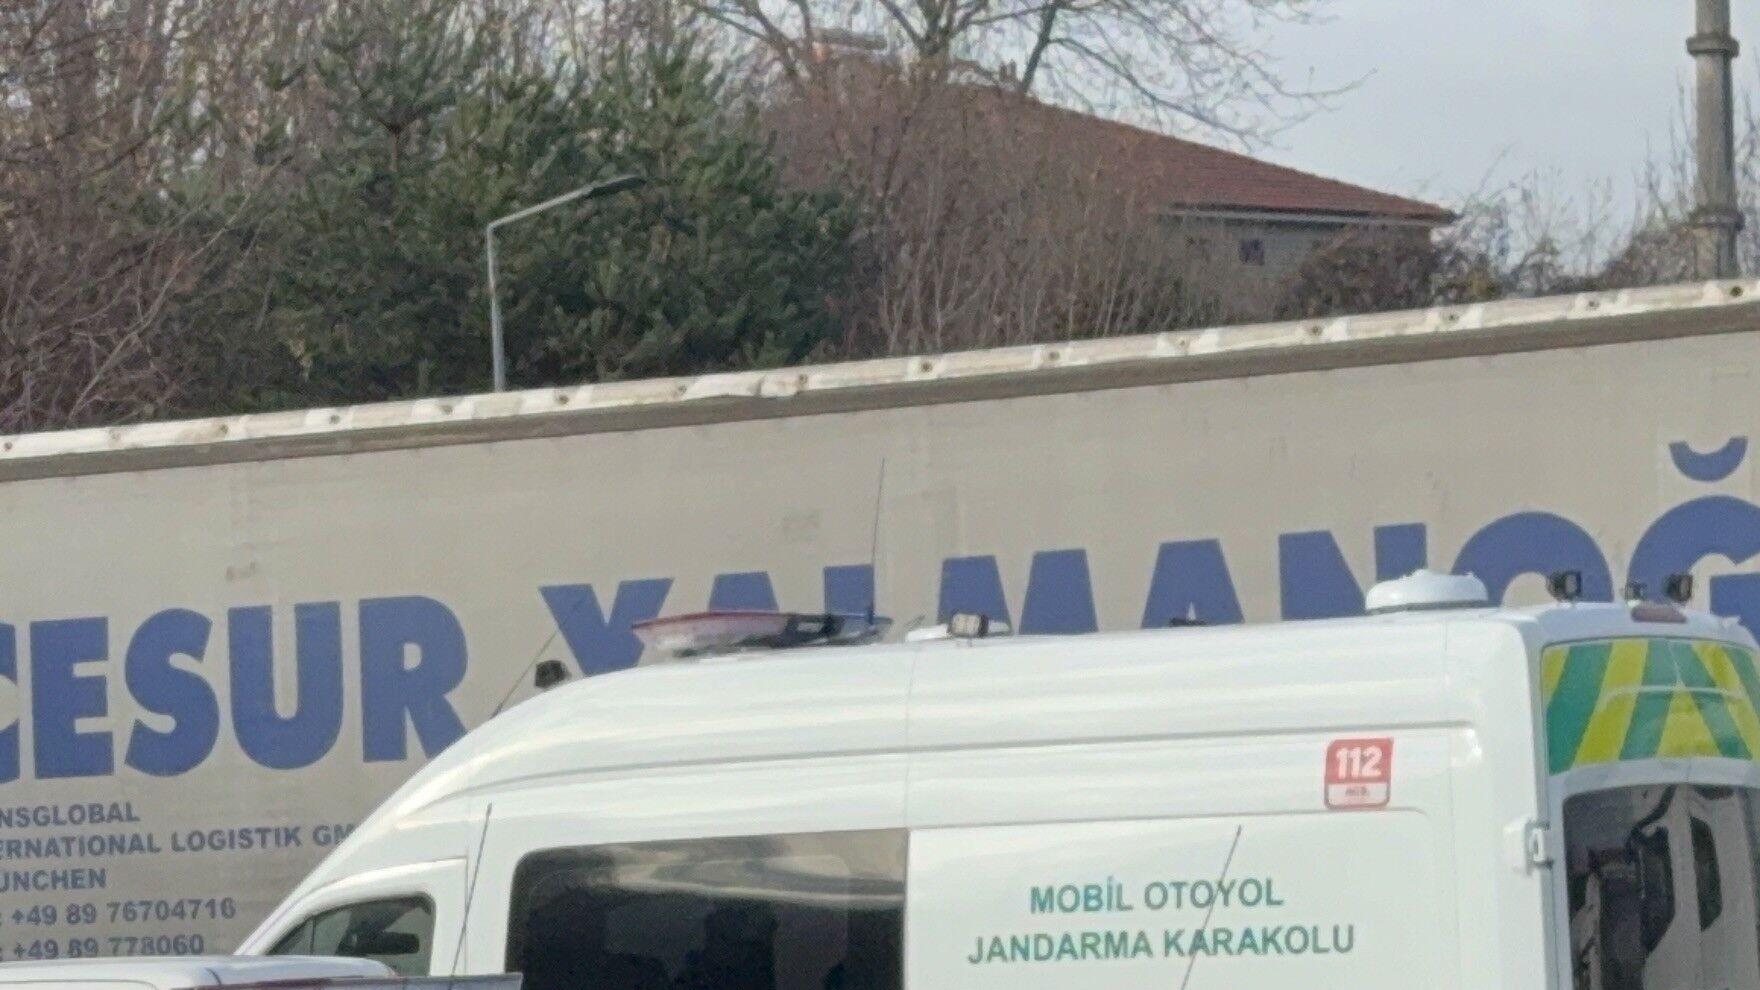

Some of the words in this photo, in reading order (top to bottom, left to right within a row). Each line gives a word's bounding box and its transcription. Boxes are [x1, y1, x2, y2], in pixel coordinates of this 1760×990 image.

[1335, 746, 1382, 779] 112
[171, 825, 302, 853] LOGISTIK
[1030, 876, 1132, 915] MOBİL
[1144, 878, 1284, 911] OTOYOL
[11, 904, 57, 927] +49
[66, 903, 97, 924] 89
[13, 938, 60, 960] +49
[968, 930, 1151, 965] JANDARMA
[1164, 925, 1355, 957] KARAKOLU
